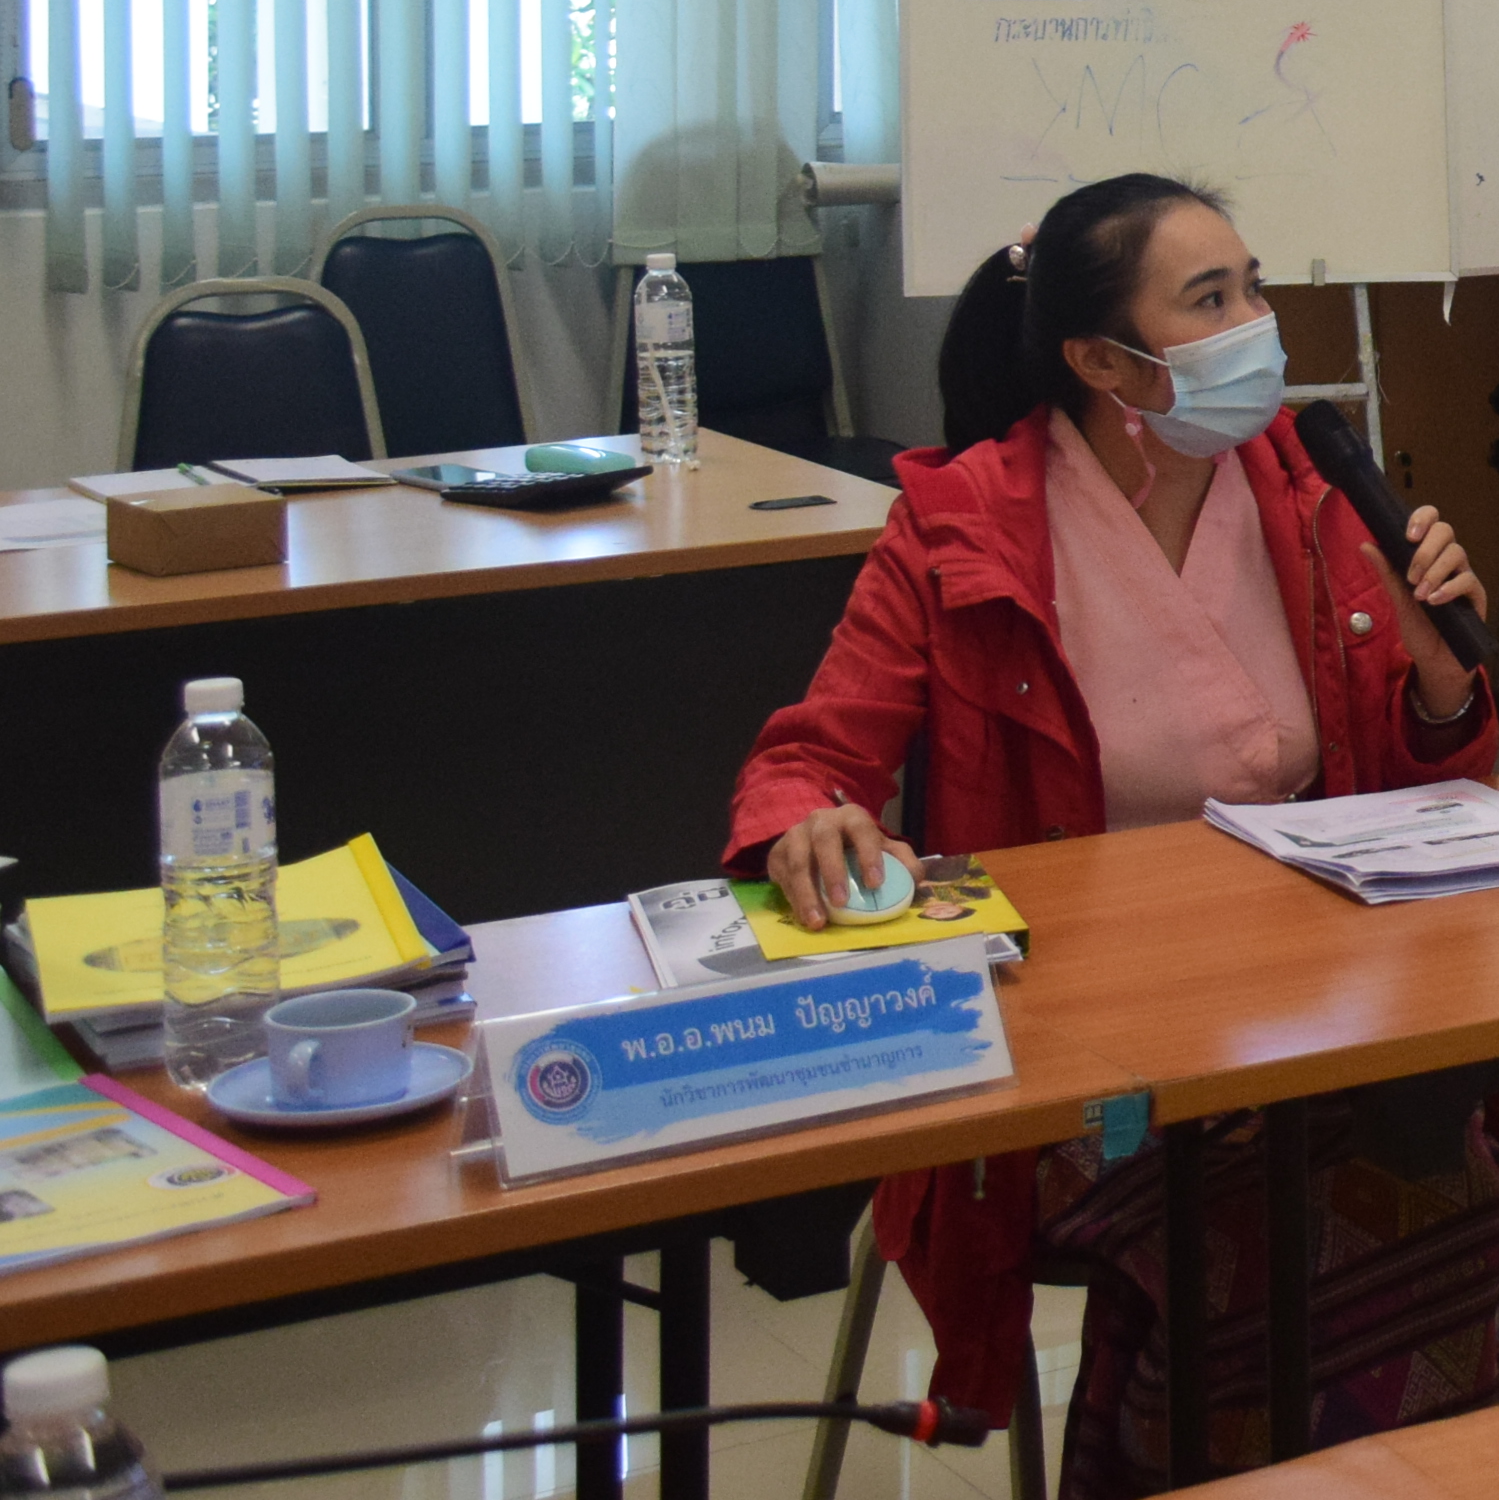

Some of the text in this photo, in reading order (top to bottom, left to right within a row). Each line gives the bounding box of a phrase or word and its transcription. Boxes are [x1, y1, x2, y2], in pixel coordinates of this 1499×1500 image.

[620, 974, 938, 1062] พ.อ.อ.พนม ปัญญาวงค์
